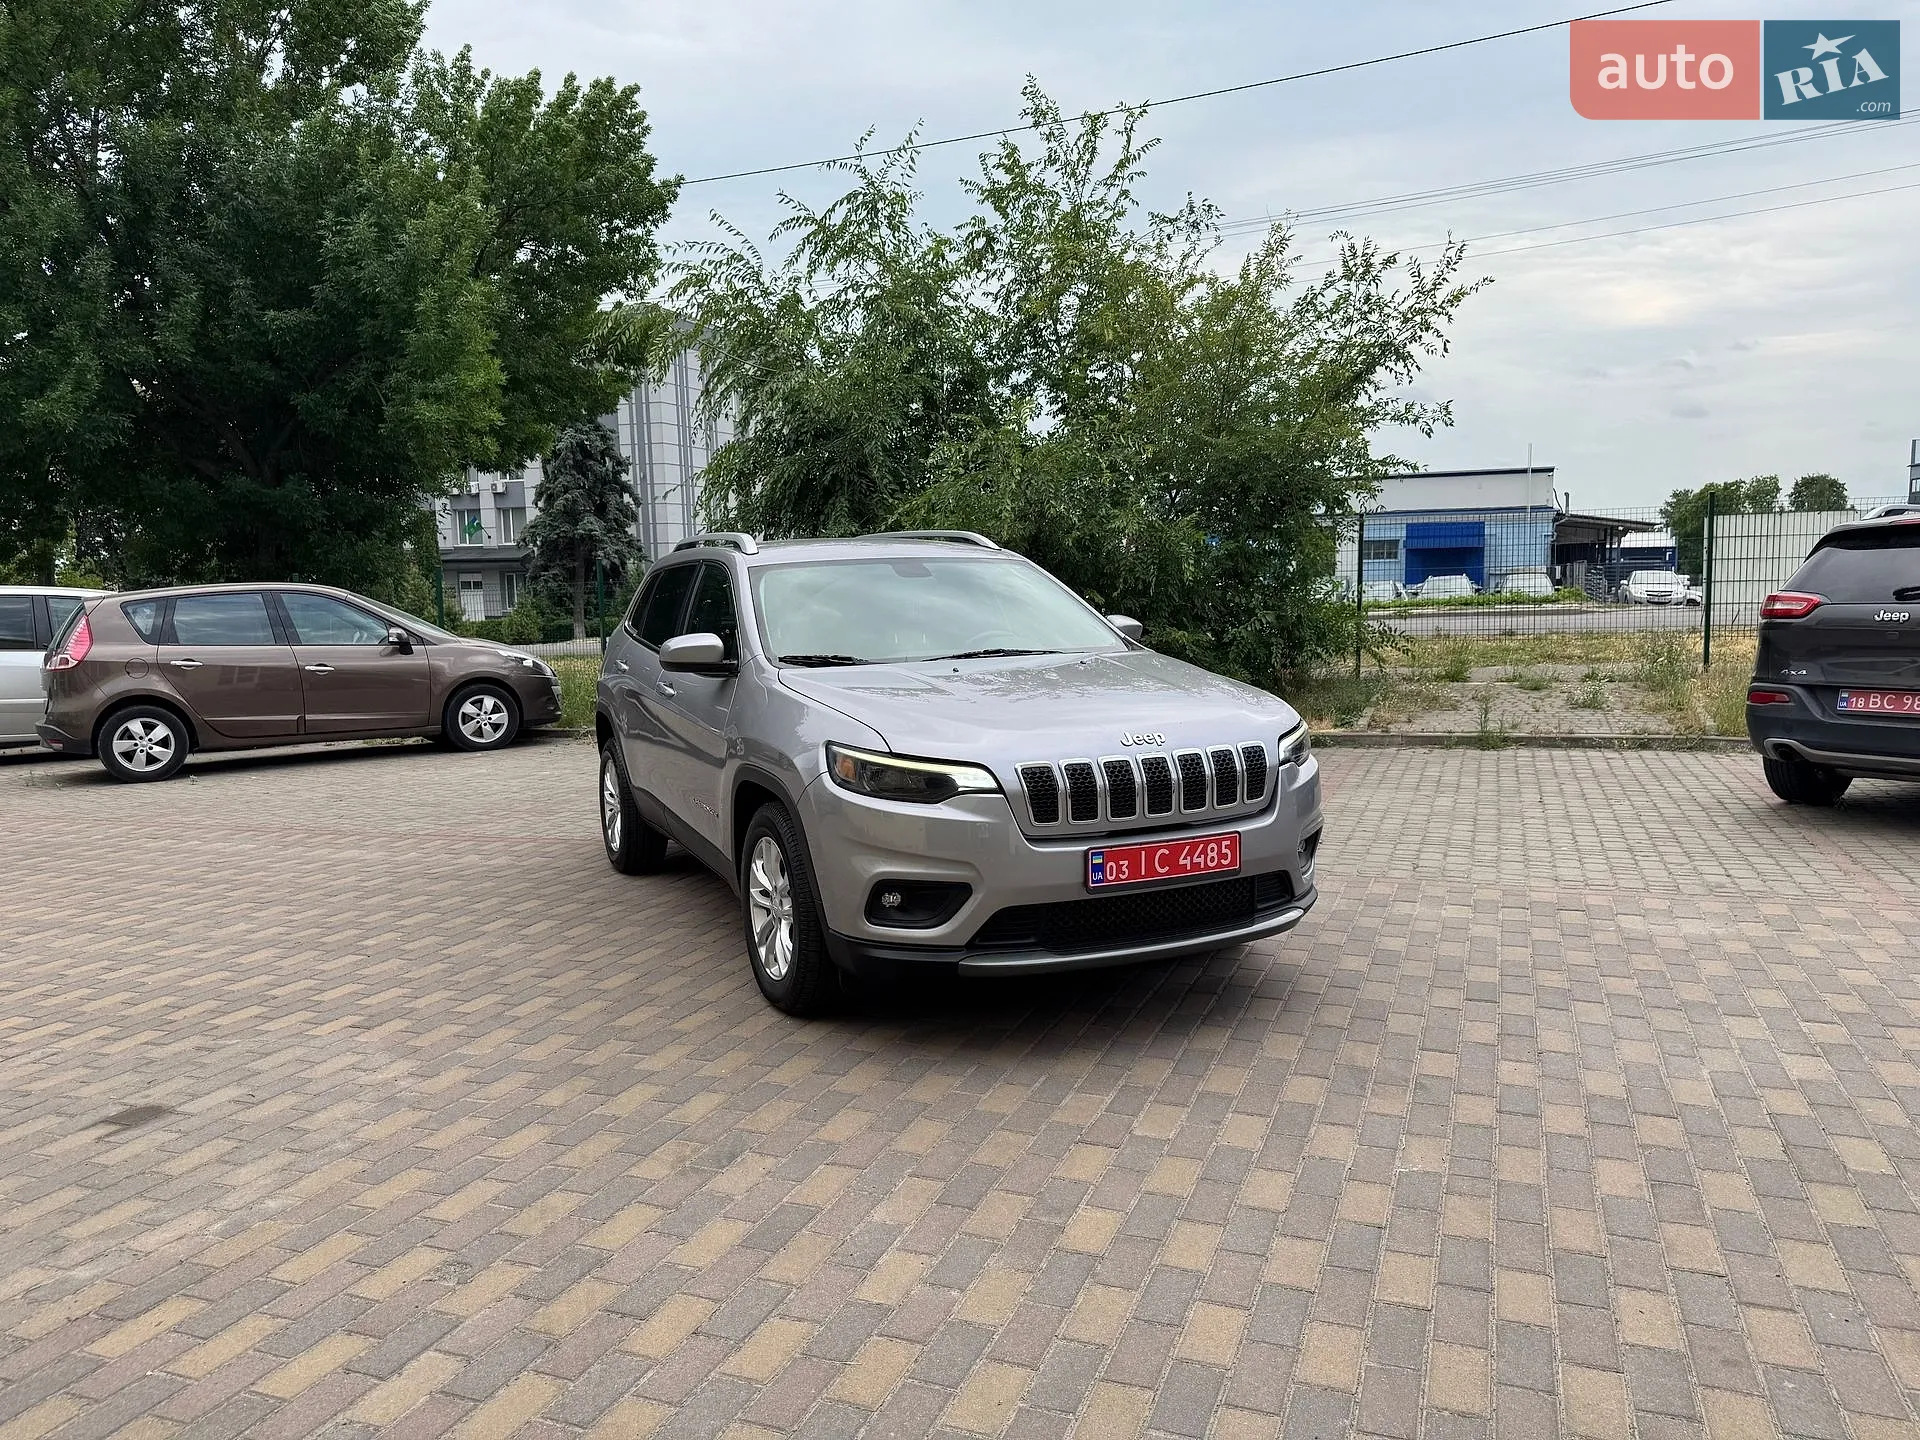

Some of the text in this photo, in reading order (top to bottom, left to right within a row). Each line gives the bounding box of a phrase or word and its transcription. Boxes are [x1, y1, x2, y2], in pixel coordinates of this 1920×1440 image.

[1873, 609, 1910, 623] Jeep
[1850, 697, 1865, 708] 18
[1869, 693, 1896, 709] BC
[1120, 731, 1166, 747] Jeep
[1092, 872, 1103, 881] UA
[1106, 860, 1129, 881] 03
[1178, 840, 1232, 870] 4485
